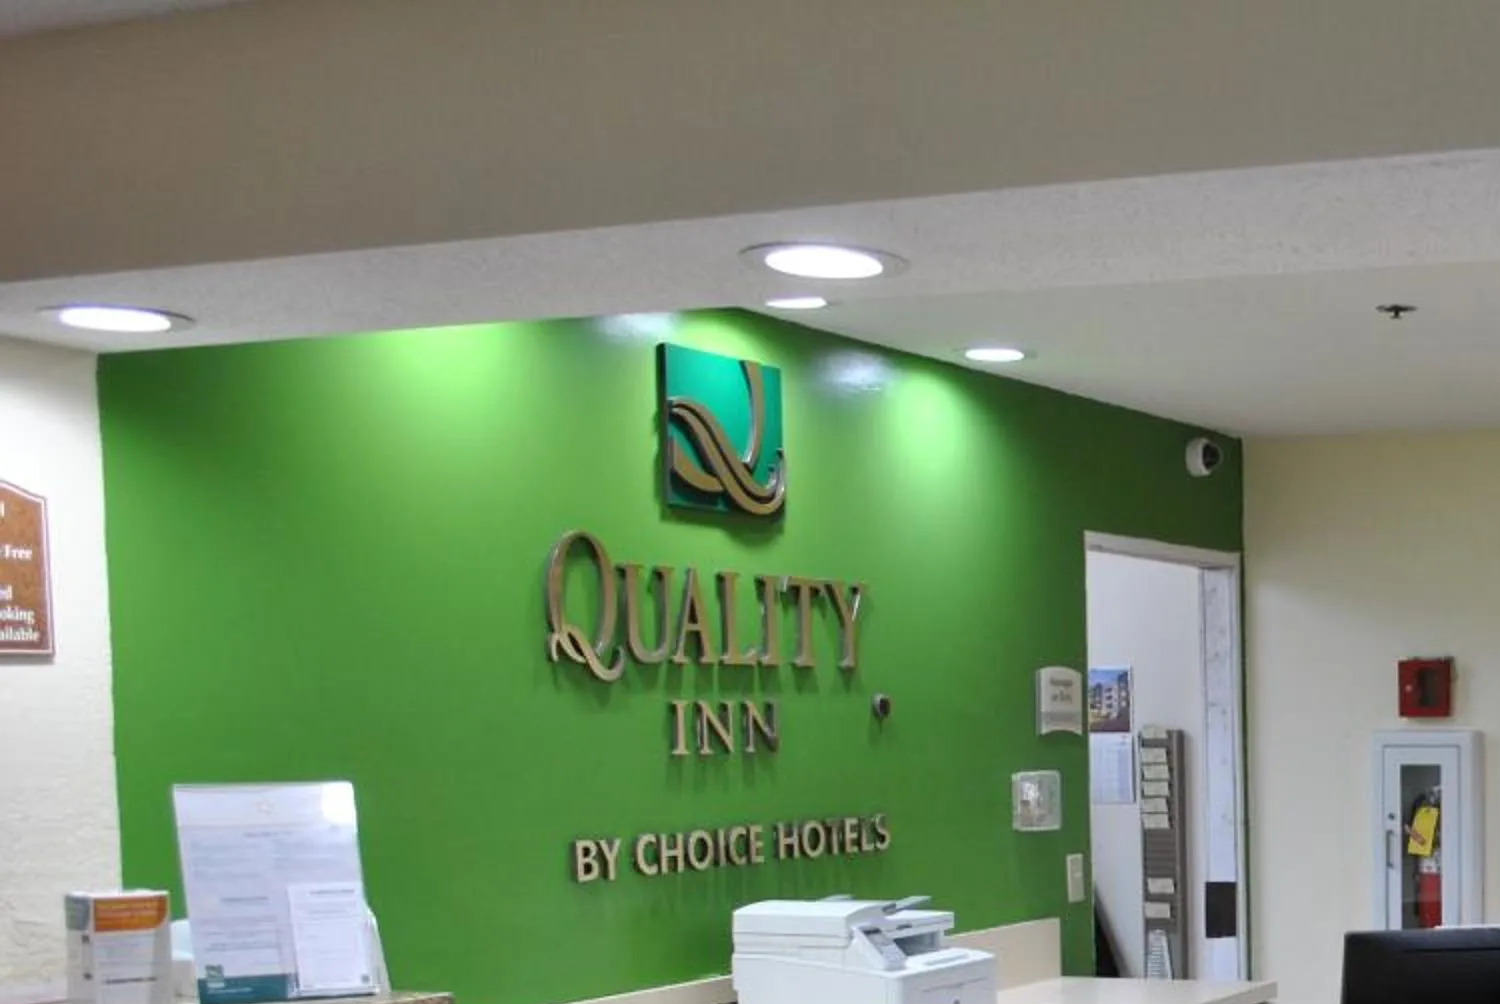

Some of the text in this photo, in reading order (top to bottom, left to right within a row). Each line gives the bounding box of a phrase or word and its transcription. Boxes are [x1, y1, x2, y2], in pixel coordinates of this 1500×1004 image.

[545, 530, 868, 682] QUALITY
[669, 699, 780, 755] INN
[574, 814, 891, 884] BY CHOICE HOTELS
